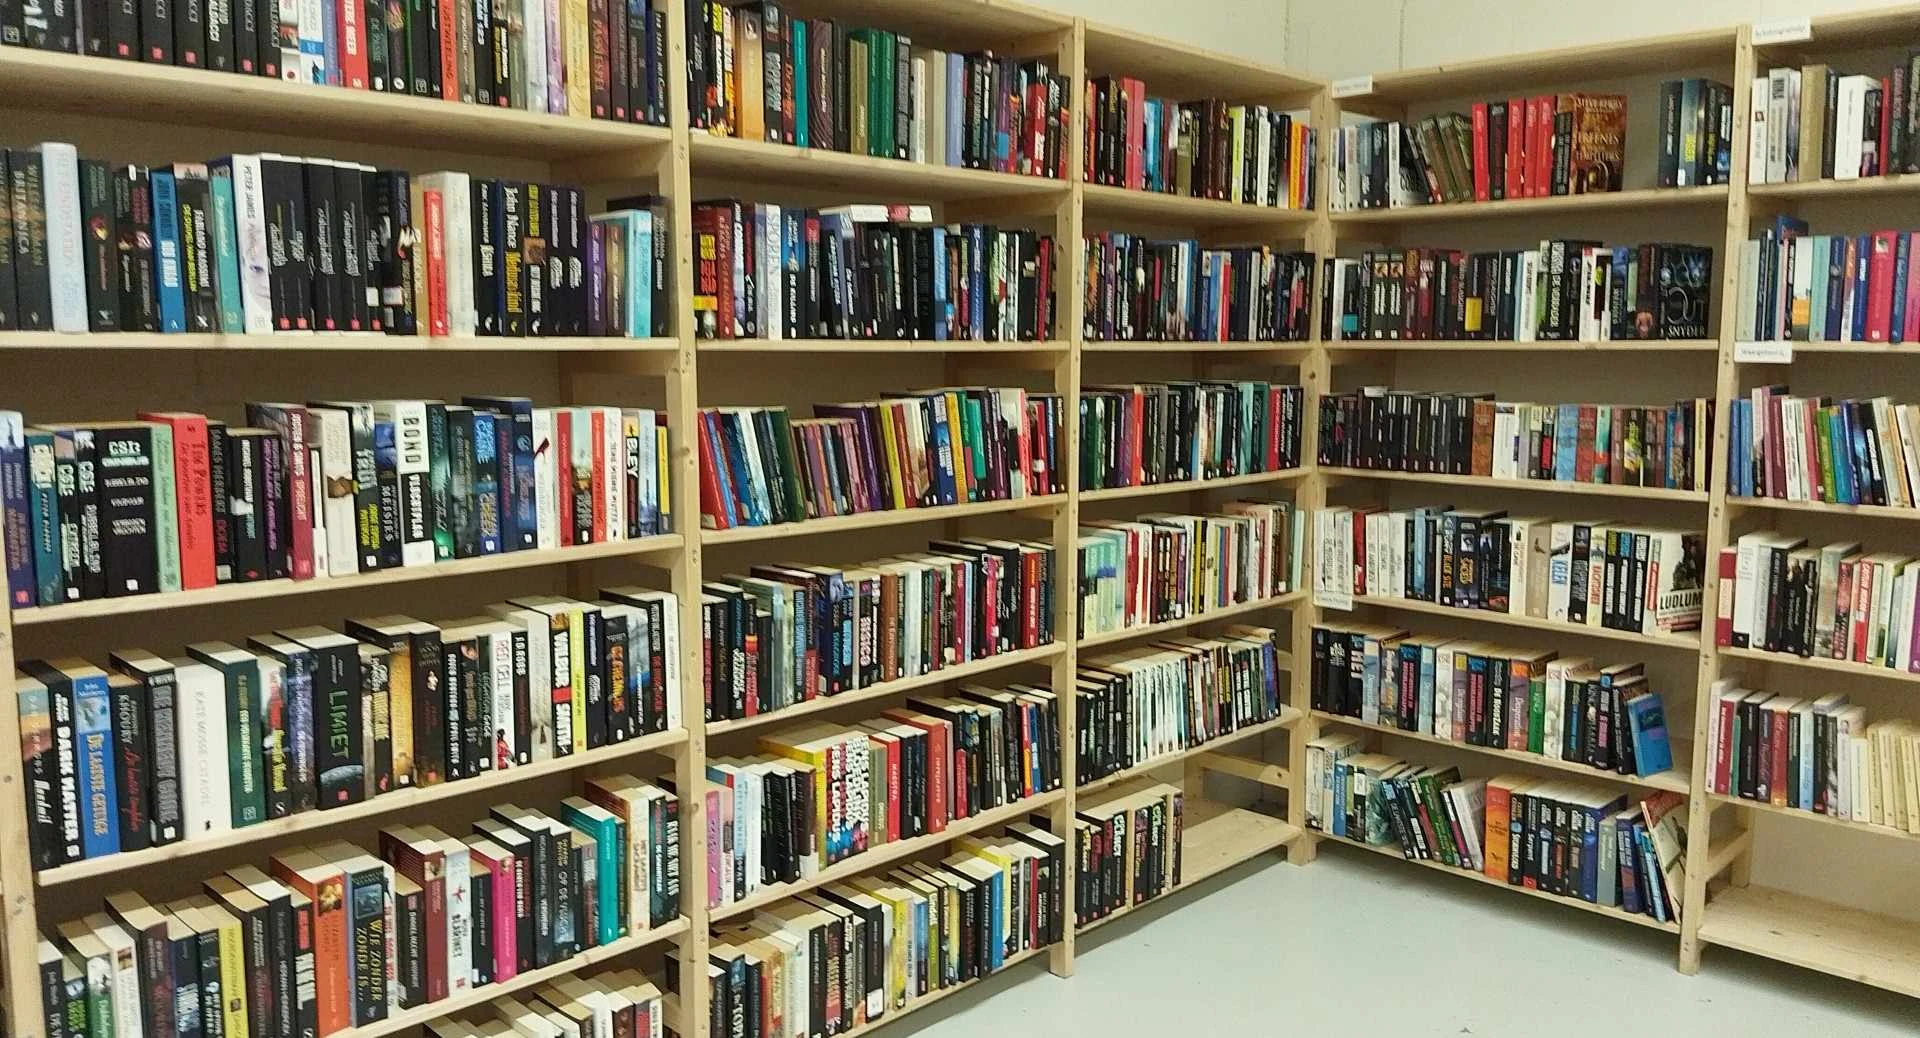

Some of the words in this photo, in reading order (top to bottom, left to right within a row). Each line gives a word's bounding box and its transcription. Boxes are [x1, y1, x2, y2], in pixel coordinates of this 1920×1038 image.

[244, 166, 255, 191] PETER
[14, 171, 29, 254] BRITANNICA
[246, 192, 256, 218] JAMES
[504, 187, 518, 212] John
[507, 214, 519, 248] Nance
[626, 438, 638, 478] BLEY
[58, 464, 75, 496] CSI:
[78, 461, 95, 493] CSI:
[1447, 555, 1456, 573] BLACK
[1447, 575, 1456, 589] SITE
[1659, 590, 1702, 611] LUDLUM
[495, 639, 510, 661] RED
[554, 632, 570, 687] WILBUR
[1350, 651, 1362, 679] HET
[497, 664, 511, 690] CELL
[118, 694, 133, 744] KHOURY
[328, 690, 349, 760] LIMIET
[482, 714, 492, 739] GAGE
[556, 703, 571, 747] SMITH
[1512, 697, 1523, 737] Desperation
[56, 726, 74, 776] DARK
[87, 735, 104, 748] DE
[88, 753, 105, 792] LAATSTE
[833, 747, 842, 780] JENS
[61, 777, 80, 841] MATTER
[91, 793, 108, 836] GETUIGE
[832, 781, 841, 843] LAPIDUS
[369, 919, 383, 946] WIE
[356, 928, 368, 973] ZONDE
[370, 950, 383, 1001] ZONDER
